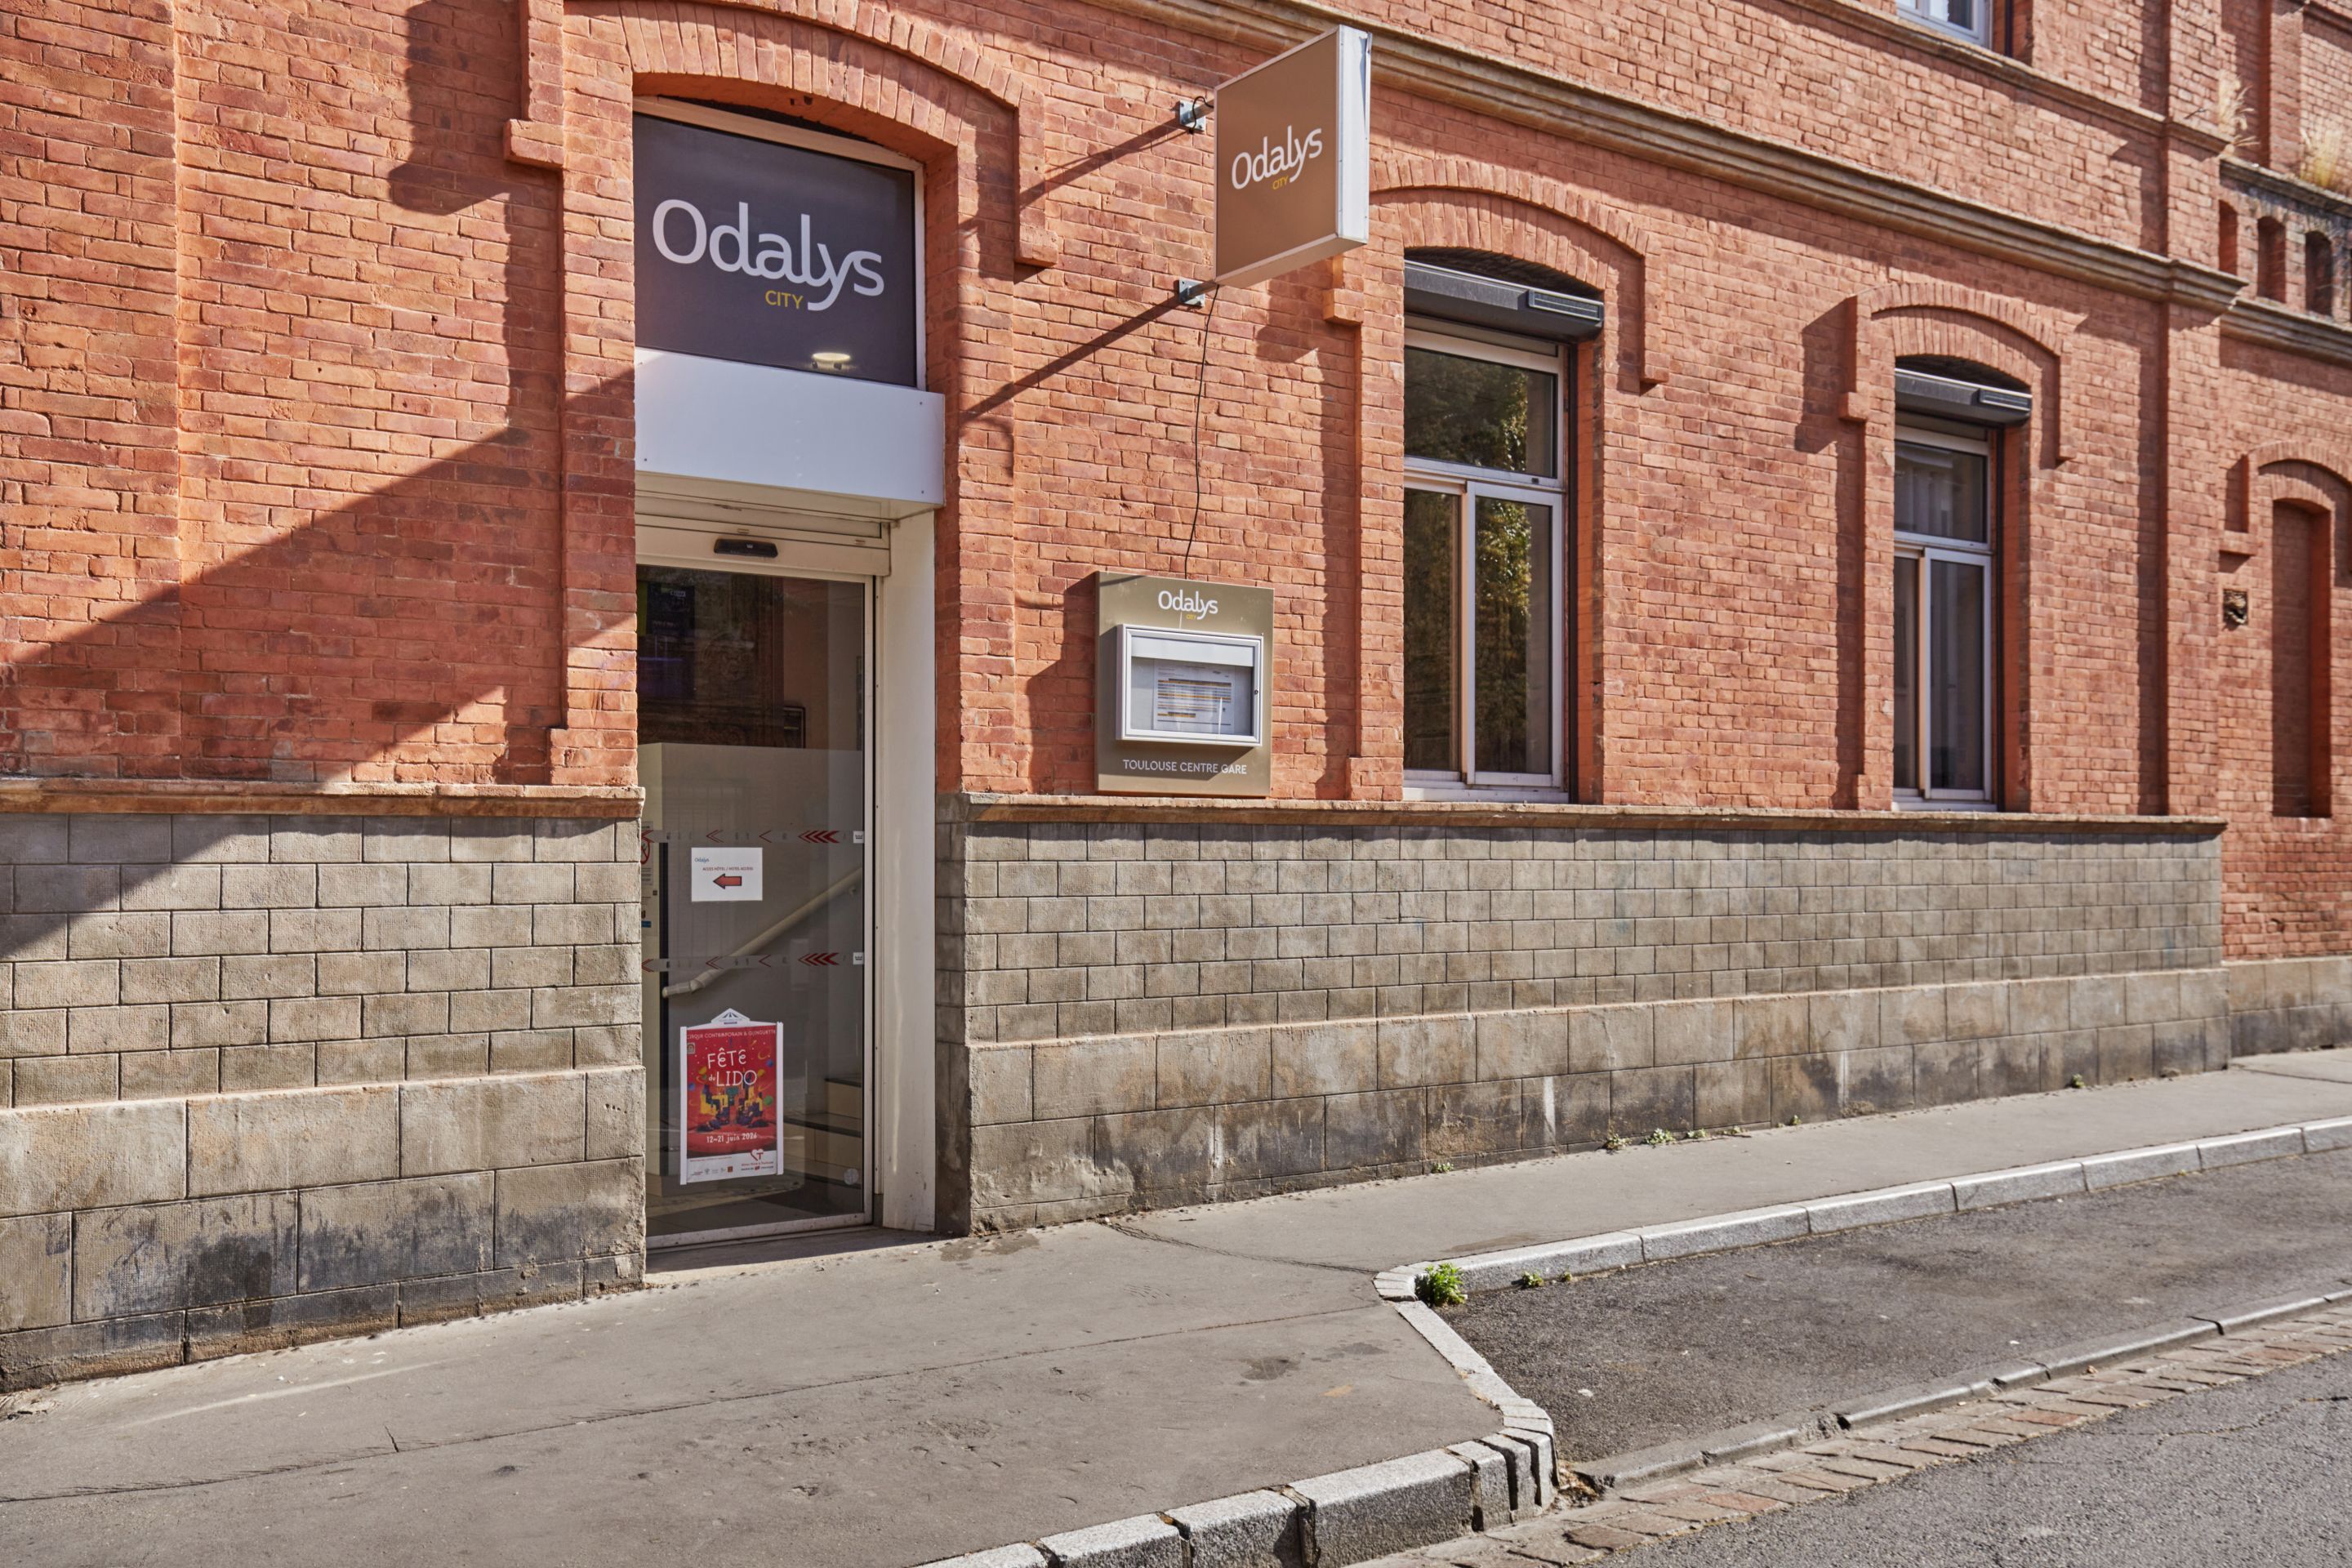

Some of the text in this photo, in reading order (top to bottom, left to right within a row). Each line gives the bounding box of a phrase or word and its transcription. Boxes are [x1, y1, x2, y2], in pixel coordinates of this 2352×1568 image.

[1232, 125, 1323, 189] Odalys
[1272, 176, 1290, 189] CITY
[652, 198, 885, 311] Odalys
[764, 289, 804, 310] CITY
[1158, 589, 1218, 620] Odalys
[1123, 759, 1248, 775] TOULOUSE CENTRE GARE
[708, 1069, 758, 1087] du LIDO
[726, 1134, 740, 1143] juin
[742, 1132, 757, 1140] 2026
